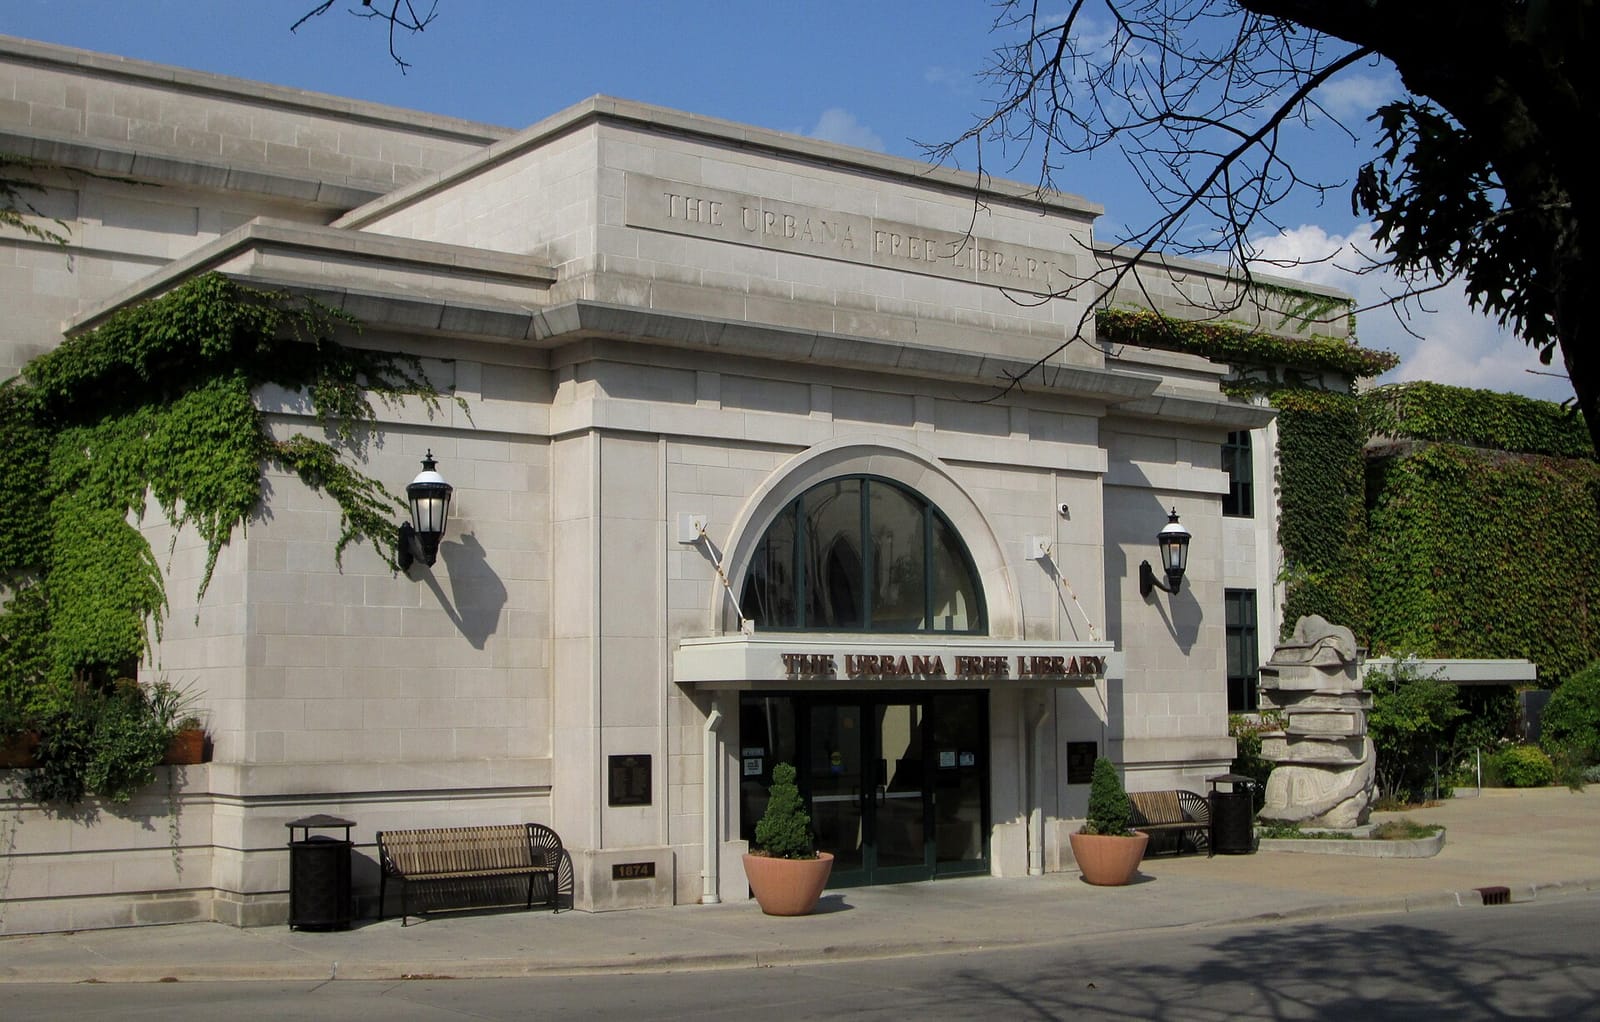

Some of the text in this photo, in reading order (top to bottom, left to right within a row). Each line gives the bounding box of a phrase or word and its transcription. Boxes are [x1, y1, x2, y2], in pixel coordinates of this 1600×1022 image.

[663, 192, 1057, 285] THE URBANA FREE LIBRARY
[781, 653, 1106, 676] THE URBANA FREE LIBRARY
[619, 864, 649, 877] 1874
